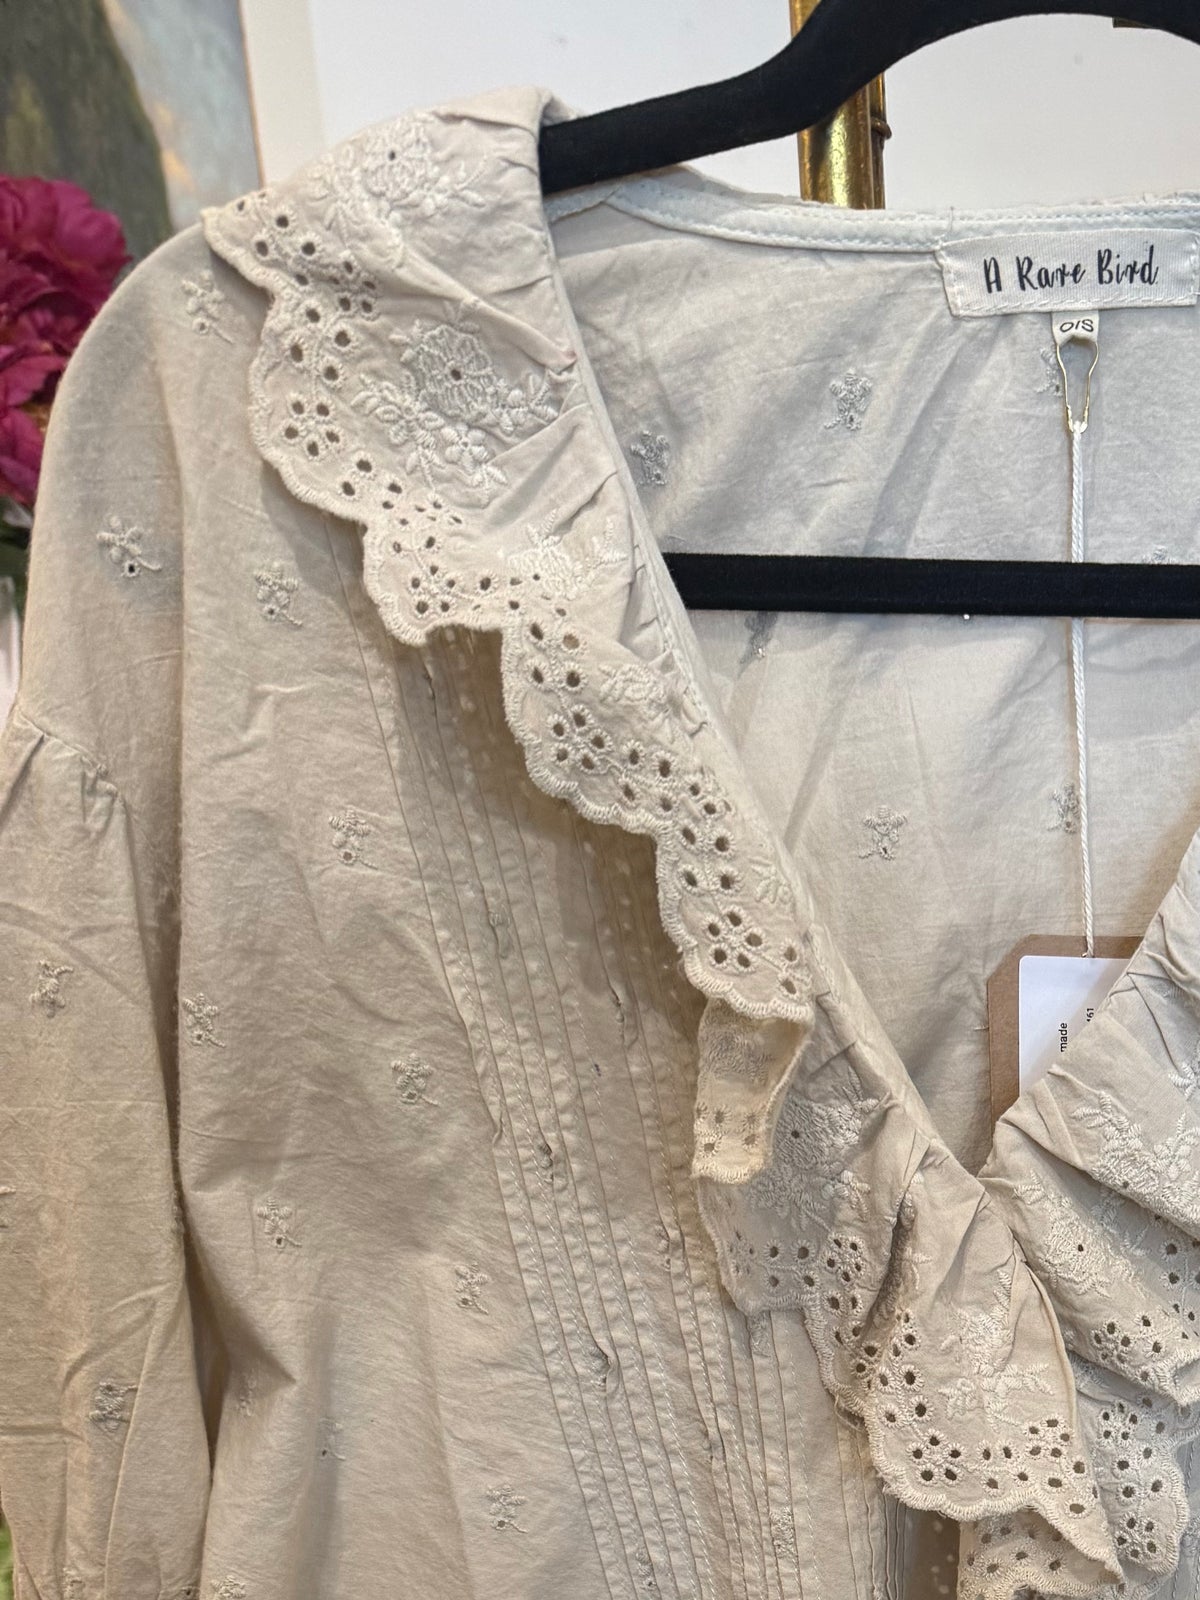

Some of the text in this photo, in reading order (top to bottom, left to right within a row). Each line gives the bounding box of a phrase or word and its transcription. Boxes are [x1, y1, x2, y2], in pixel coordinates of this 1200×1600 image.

[983, 244, 1159, 294] A Rare Bird
